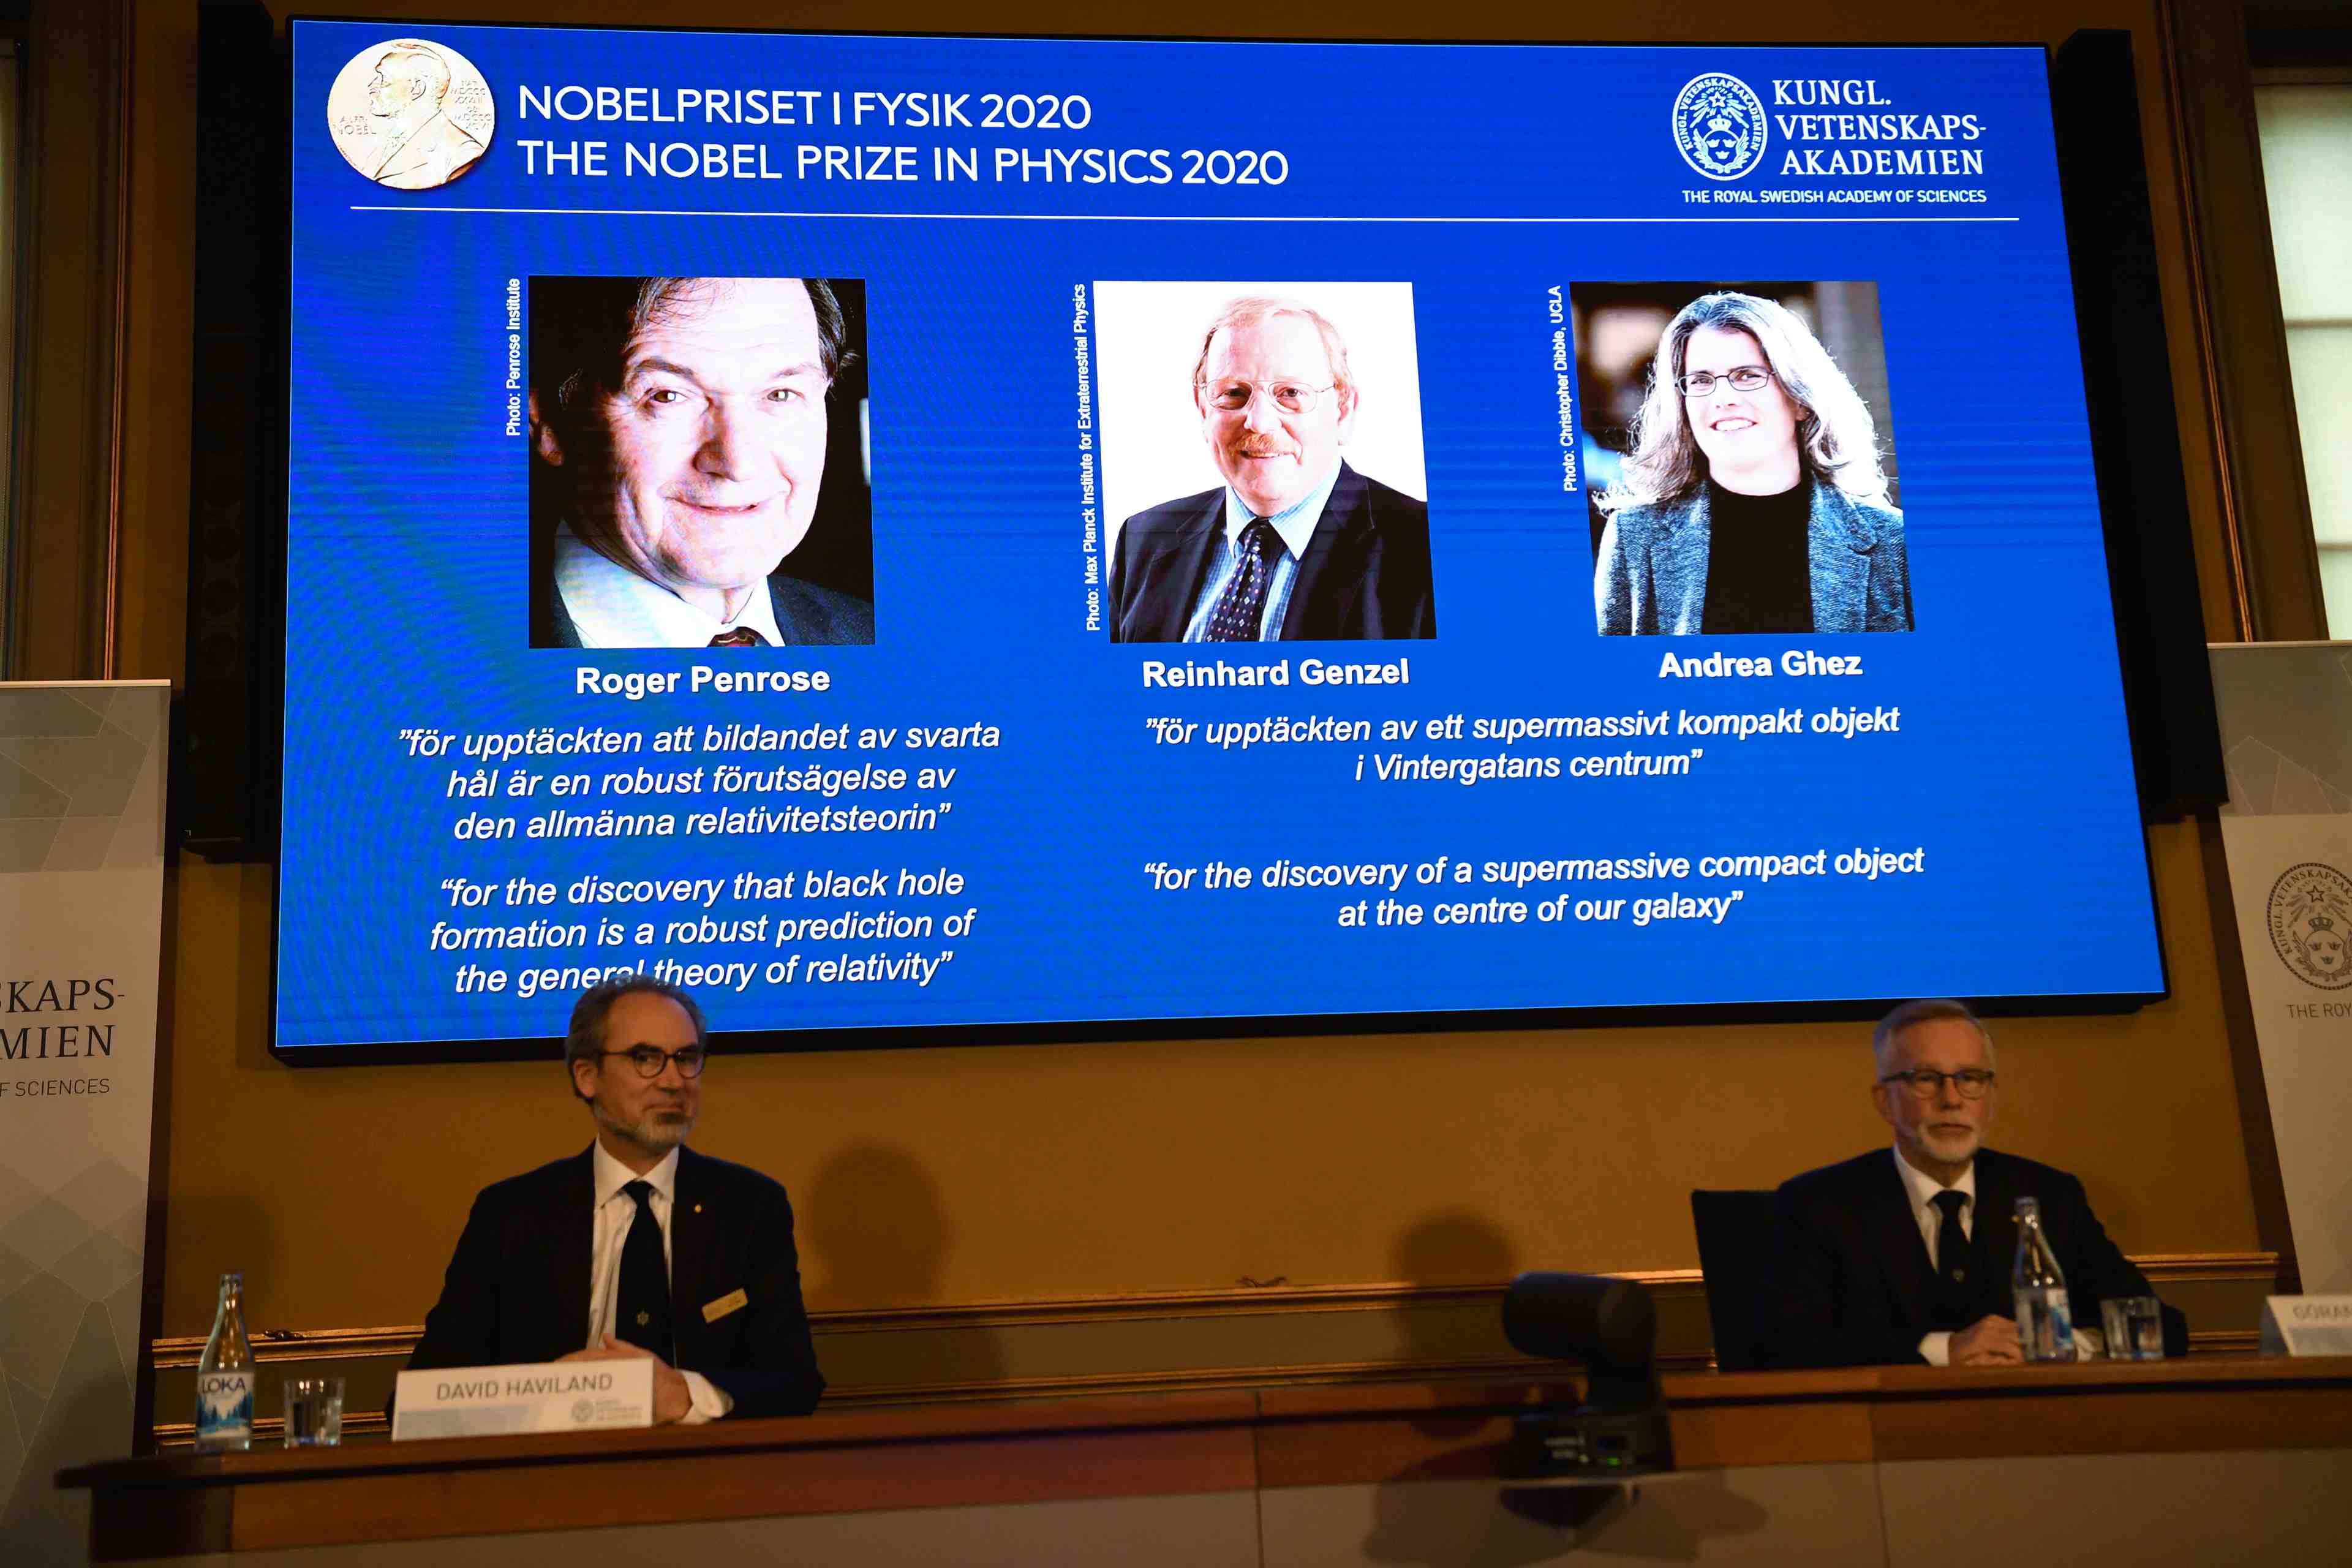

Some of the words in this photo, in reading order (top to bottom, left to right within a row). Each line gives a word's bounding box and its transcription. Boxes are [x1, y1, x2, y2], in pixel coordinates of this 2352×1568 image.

[519, 85, 822, 124] NOBELPRISET
[833, 91, 840, 125] I
[854, 92, 973, 126] FYSIK
[980, 94, 1091, 129] 2020
[1772, 80, 1891, 105] KUNGL.
[1678, 110, 1694, 151] KUNGL.
[1679, 78, 1763, 151] VETENSKAPSAKADEMIEN
[1774, 115, 1986, 140] VETENSKAPS-
[517, 140, 608, 176] THE
[625, 142, 782, 179] NOBEL
[797, 145, 918, 181] PRIZE
[934, 147, 978, 181] IN
[995, 148, 1173, 184] PHYSICS
[1181, 149, 1289, 185] 2020
[1780, 149, 1983, 175] AKADEMIEN
[1682, 190, 1711, 203] THE
[1714, 190, 1758, 203] ROYAL
[1760, 190, 1824, 203] SWEDISH
[1826, 190, 1893, 203] ACADEMY
[1896, 190, 1914, 203] OF
[1917, 190, 1987, 203] SCIENCES
[506, 278, 521, 330] Institute
[1072, 284, 1089, 333] Physics
[1548, 285, 1564, 323] UCLA
[506, 334, 521, 389] Penrose
[1552, 327, 1568, 371] Dibble,
[1074, 336, 1091, 429] Extraterrestrial
[506, 393, 521, 436] Photo:
[1556, 373, 1574, 447] Christopher
[1079, 432, 1092, 451] for
[1080, 453, 1095, 504] Institute
[1562, 450, 1578, 491] Photo:
[1082, 508, 1097, 552] Planck
[1084, 556, 1098, 584] Max
[1086, 588, 1100, 631] Photo:
[576, 667, 681, 700] Roger
[692, 666, 831, 692] Penrose
[1143, 659, 1289, 687] Reinhard
[1299, 658, 1409, 685] Genzel
[1659, 651, 1773, 678] Andrea
[1781, 650, 1863, 676] Ghez
[399, 728, 456, 756] ”för
[464, 726, 643, 762] upptäckten
[653, 725, 695, 752] att
[703, 723, 850, 752] bildandet
[858, 728, 897, 749] av
[905, 721, 1000, 748] svarta
[1146, 717, 1199, 744] ”för
[1205, 715, 1371, 750] upptäckten
[1381, 720, 1418, 741] av
[1425, 714, 1464, 740] ett
[1472, 710, 1670, 745] supermassivt
[1678, 707, 1804, 741] kompakt
[1811, 706, 1901, 739] objekt
[447, 769, 499, 797] hål
[507, 769, 543, 796] är
[551, 774, 590, 796] en
[601, 766, 704, 794] robust
[713, 763, 907, 797] förutsägelse
[917, 768, 956, 789] av
[1355, 754, 1364, 781] i
[1374, 753, 1561, 785] Vintergatans
[1569, 748, 1703, 777] centrum”
[454, 812, 516, 840] den
[526, 810, 675, 838] allmänna
[685, 802, 952, 834] relativitetsteorin”
[441, 878, 499, 907] “for
[506, 877, 557, 905] the
[568, 875, 725, 908] discovery
[734, 872, 795, 900] that
[803, 869, 889, 898] black
[897, 867, 964, 895] hole
[1144, 862, 1197, 890] “for
[1204, 861, 1252, 889] the
[1262, 859, 1409, 892] discovery
[1416, 856, 1448, 884] of
[1453, 862, 1472, 883] a
[1482, 851, 1691, 888] supermassive
[1699, 849, 1827, 883] compact
[1834, 847, 1925, 880] object
[431, 919, 587, 950] formation
[597, 917, 625, 946] is
[635, 923, 654, 944] a
[665, 914, 769, 944] robust
[775, 910, 932, 948] prediction
[943, 908, 978, 937] of
[1338, 900, 1368, 927] at
[1376, 898, 1423, 926] the
[1433, 897, 1528, 924] centre
[1537, 894, 1569, 922] of
[1575, 899, 1627, 921] our
[1632, 890, 1744, 926] galaxy”
[456, 964, 507, 993] the
[654, 958, 758, 992] theory
[766, 954, 801, 984] of
[806, 951, 954, 987] relativity”
[0, 978, 125, 1014] KAPS-
[2286, 1004, 2319, 1019] THE
[0, 1024, 117, 1060] MIEN
[15, 1078, 110, 1097] SCIENCES
[202, 1377, 246, 1393] LOKA
[437, 1381, 499, 1401] DAVID
[507, 1373, 612, 1396] HAVILAND
